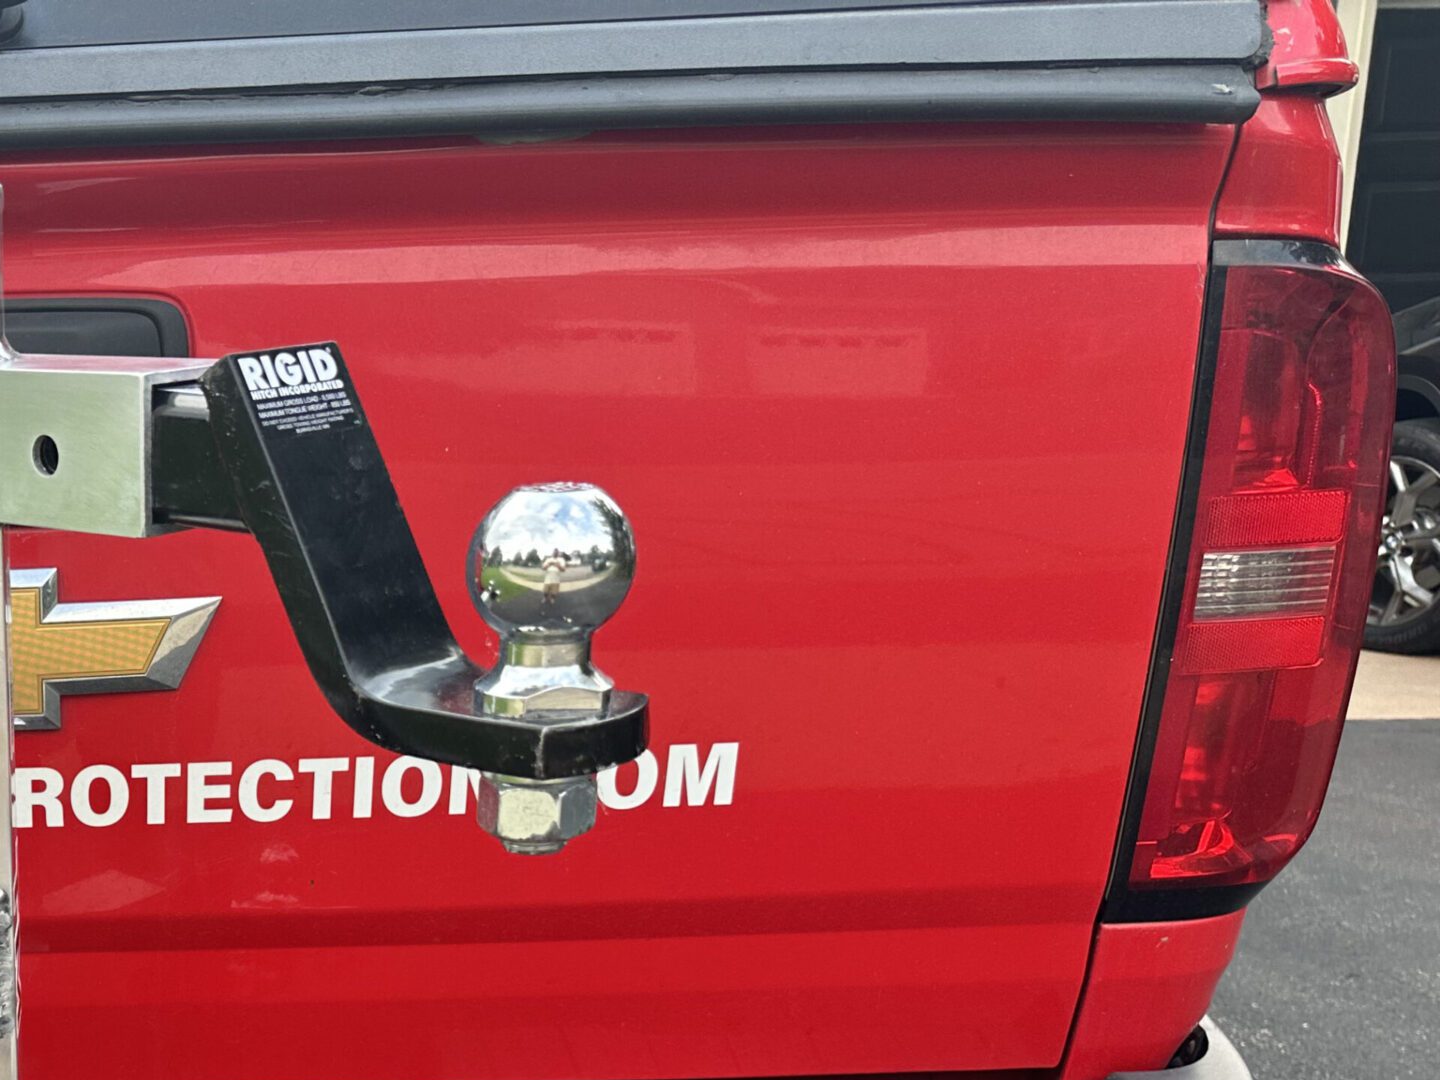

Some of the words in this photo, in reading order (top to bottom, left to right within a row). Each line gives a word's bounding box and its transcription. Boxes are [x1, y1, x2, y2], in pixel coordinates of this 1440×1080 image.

[237, 348, 338, 391] RIGID
[250, 387, 277, 401] HITCH
[279, 379, 345, 396] INCORPORATED
